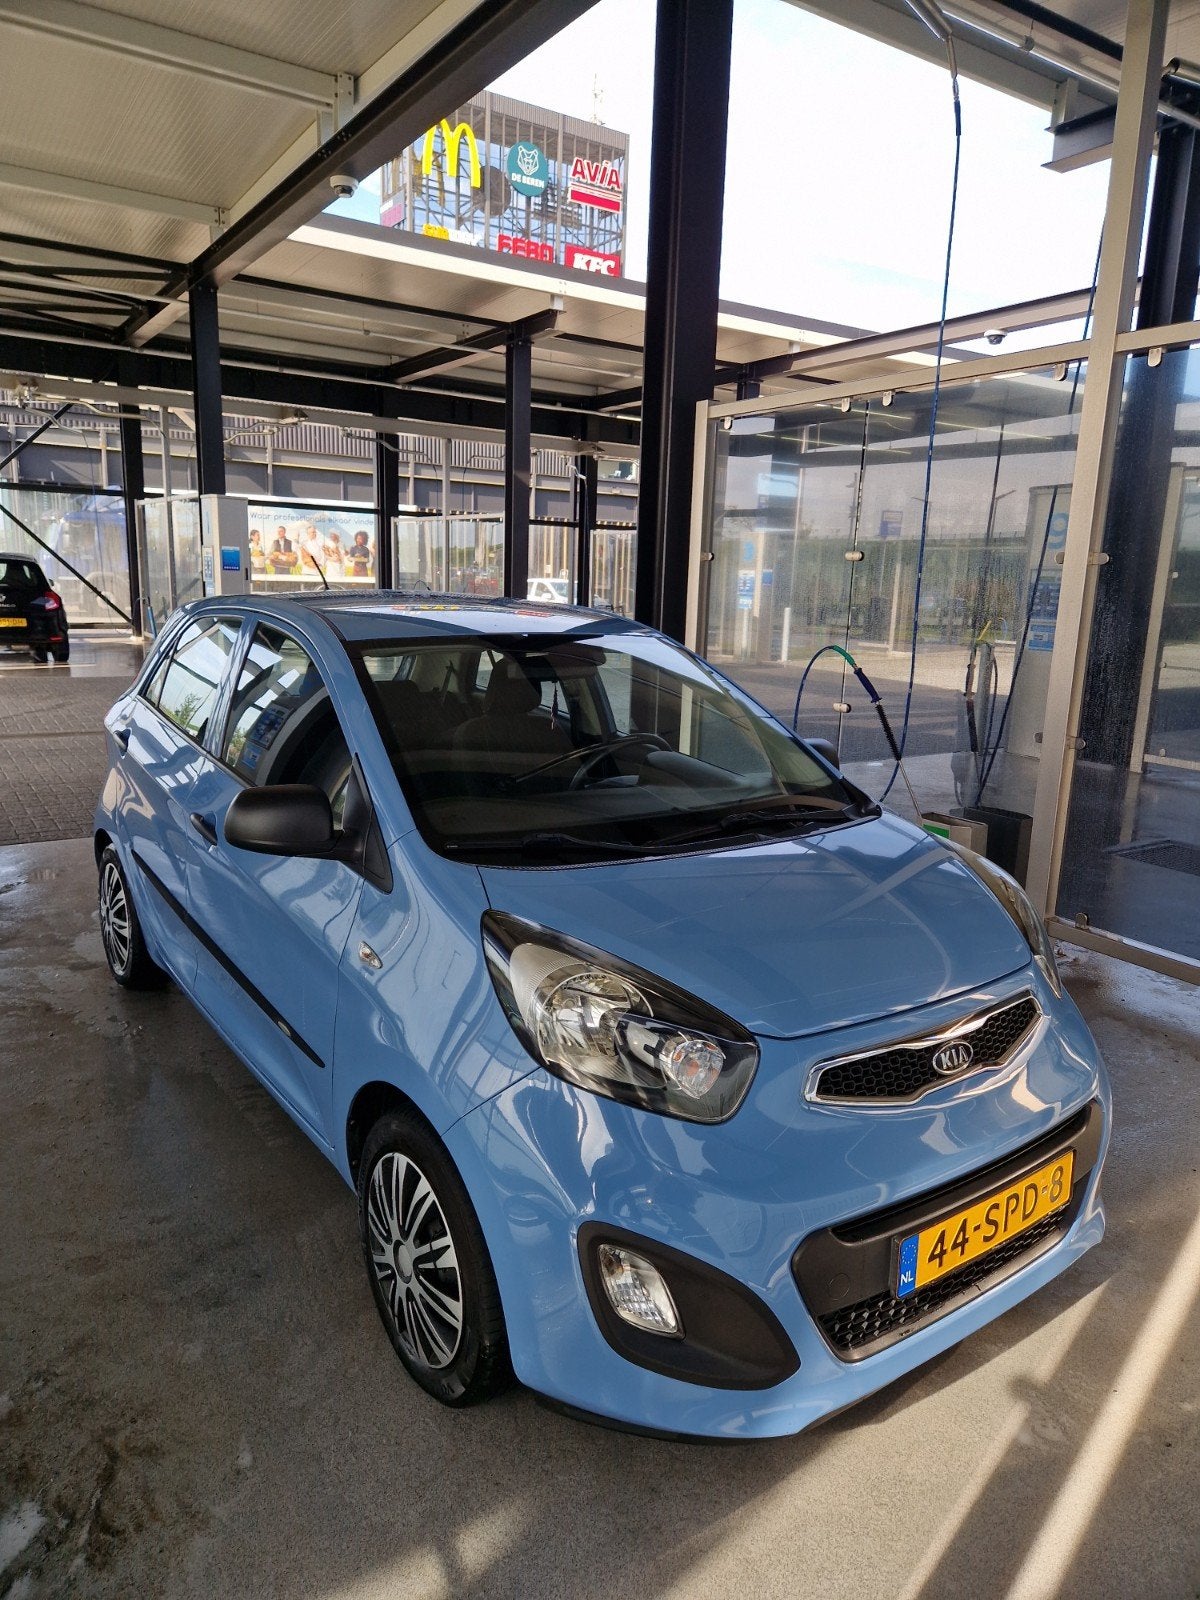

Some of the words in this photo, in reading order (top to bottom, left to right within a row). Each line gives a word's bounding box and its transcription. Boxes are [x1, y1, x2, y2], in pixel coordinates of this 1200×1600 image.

[511, 172, 522, 183] DE
[522, 175, 545, 189] BEREN
[571, 156, 622, 191] AVIA
[497, 233, 555, 264] FEBO
[573, 252, 616, 277] KFC
[250, 512, 272, 521] Waar
[273, 513, 326, 524] professionals
[328, 516, 351, 525] elkaar
[354, 518, 374, 527] vinde
[940, 1045, 969, 1070] KIA
[927, 1165, 1065, 1269] 44-SPD-8
[900, 1269, 914, 1286] NL
